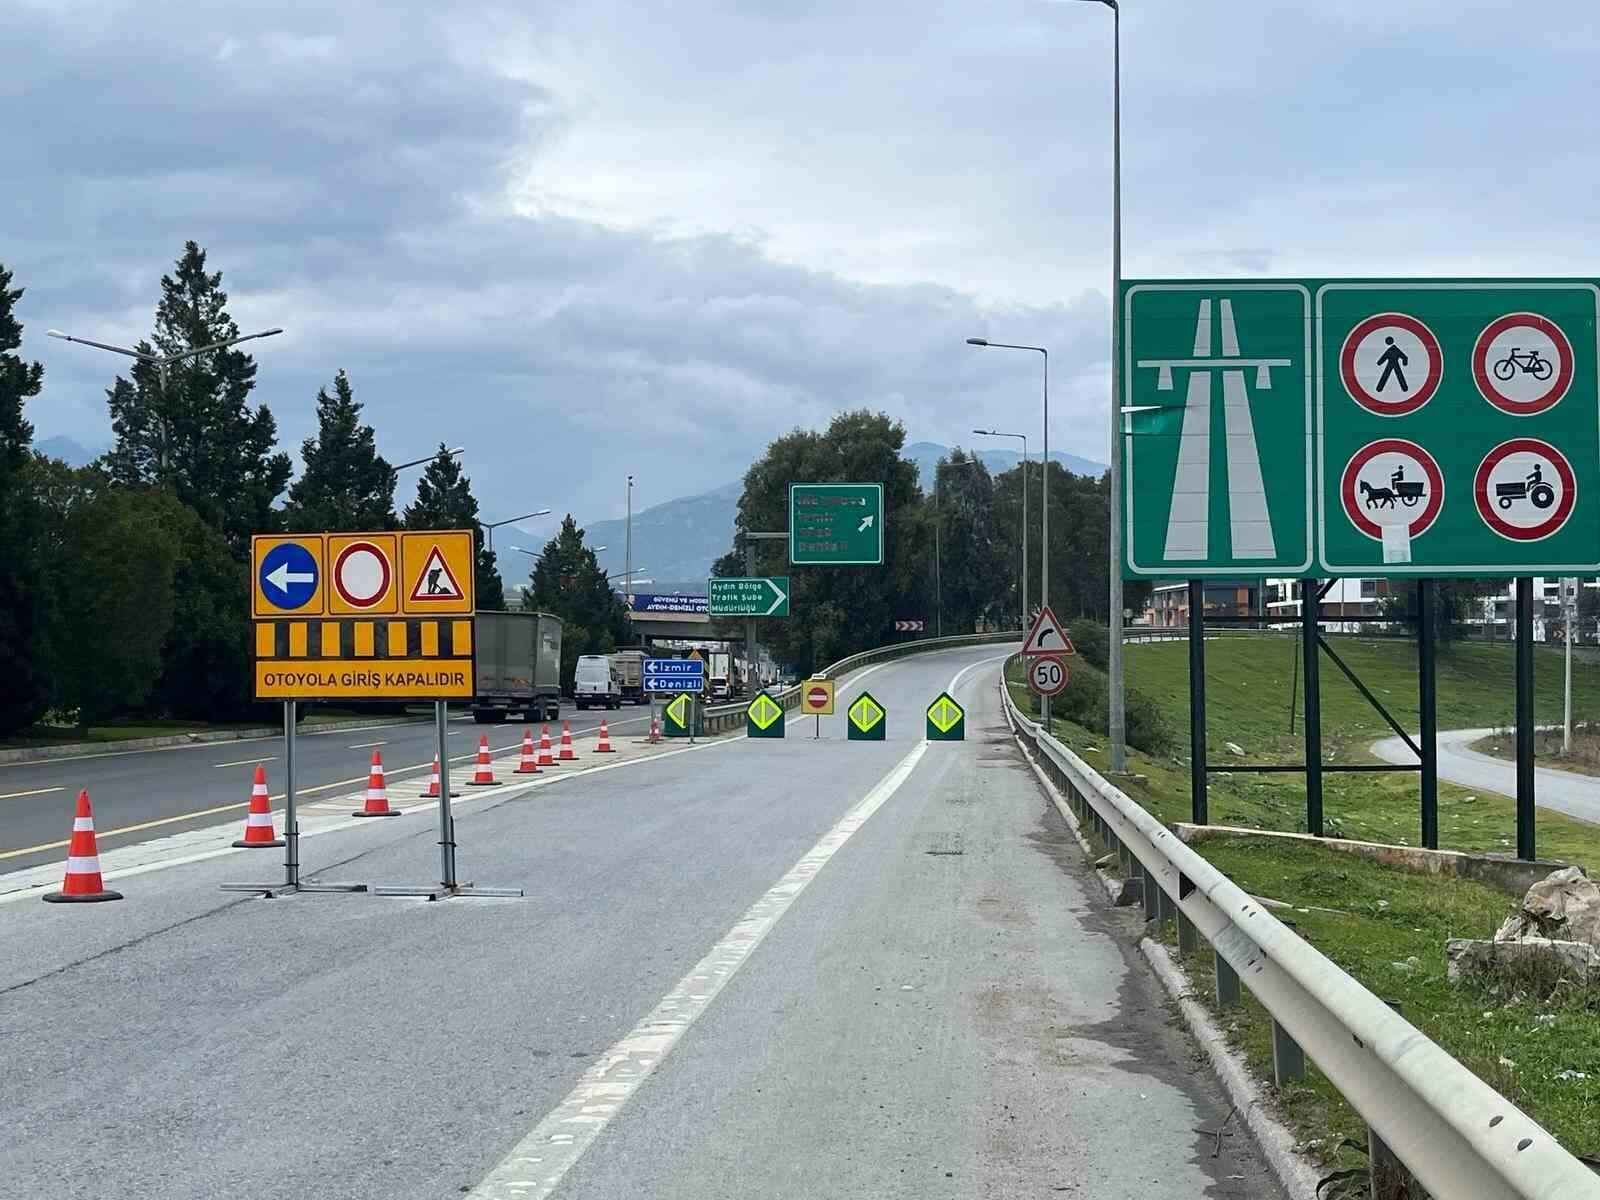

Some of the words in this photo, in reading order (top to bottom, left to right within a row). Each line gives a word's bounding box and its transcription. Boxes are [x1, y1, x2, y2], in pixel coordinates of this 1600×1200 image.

[712, 583, 736, 591] Aydın
[738, 583, 762, 591] Bölge
[660, 660, 692, 672] İzmir
[264, 672, 338, 687] OTOYOLA
[341, 670, 381, 689] GİRİŞ
[385, 672, 465, 687] KAPALIDIR
[1037, 665, 1061, 685] 50
[659, 679, 701, 689] Denizli
